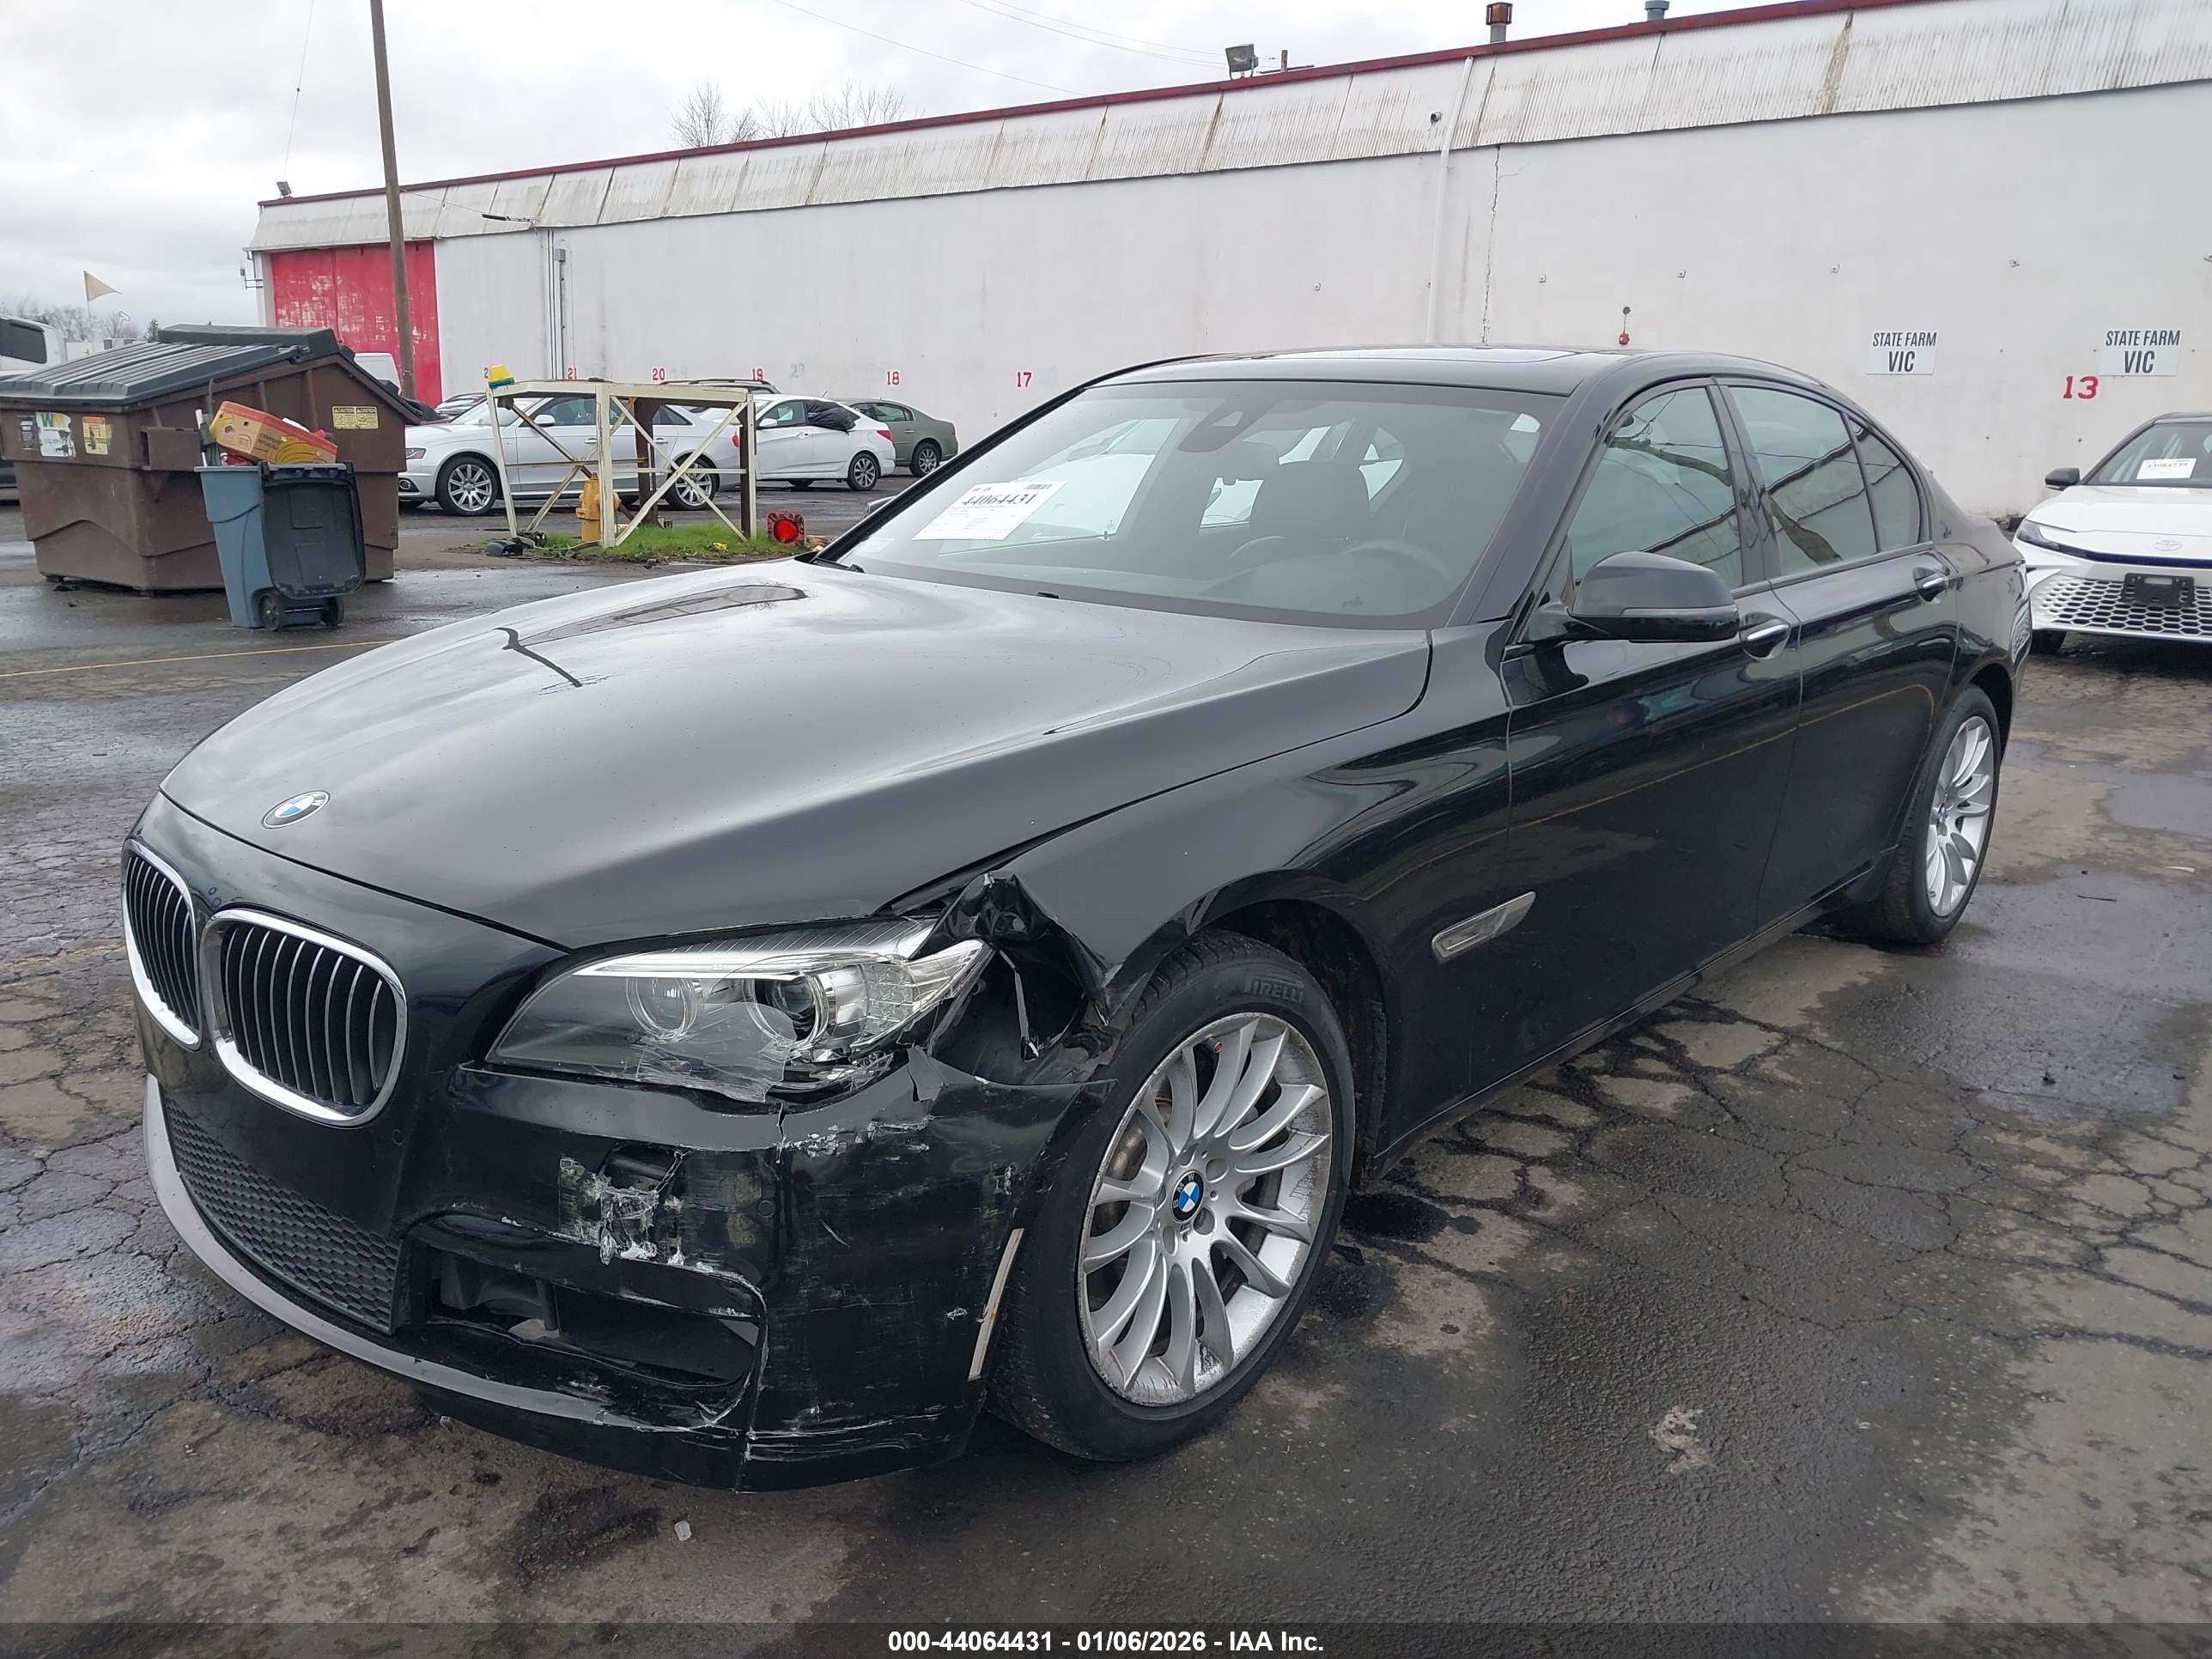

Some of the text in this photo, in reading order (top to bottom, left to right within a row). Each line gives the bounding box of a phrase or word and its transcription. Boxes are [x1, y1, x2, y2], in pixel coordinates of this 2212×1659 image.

[1872, 331, 1937, 347] STATE FARM
[2106, 330, 2181, 346] STATE FARM
[1888, 350, 1916, 373] VIC
[2124, 350, 2155, 374] VIC
[567, 367, 578, 380] 21
[652, 368, 665, 380] 20
[751, 368, 763, 381] 19
[886, 371, 900, 386] 18
[1017, 371, 1032, 387] 17
[2063, 375, 2099, 399] 13
[962, 493, 1039, 506] 44064431
[1243, 975, 1304, 1004] PIRELLI
[1172, 1173, 1195, 1209] BMW
